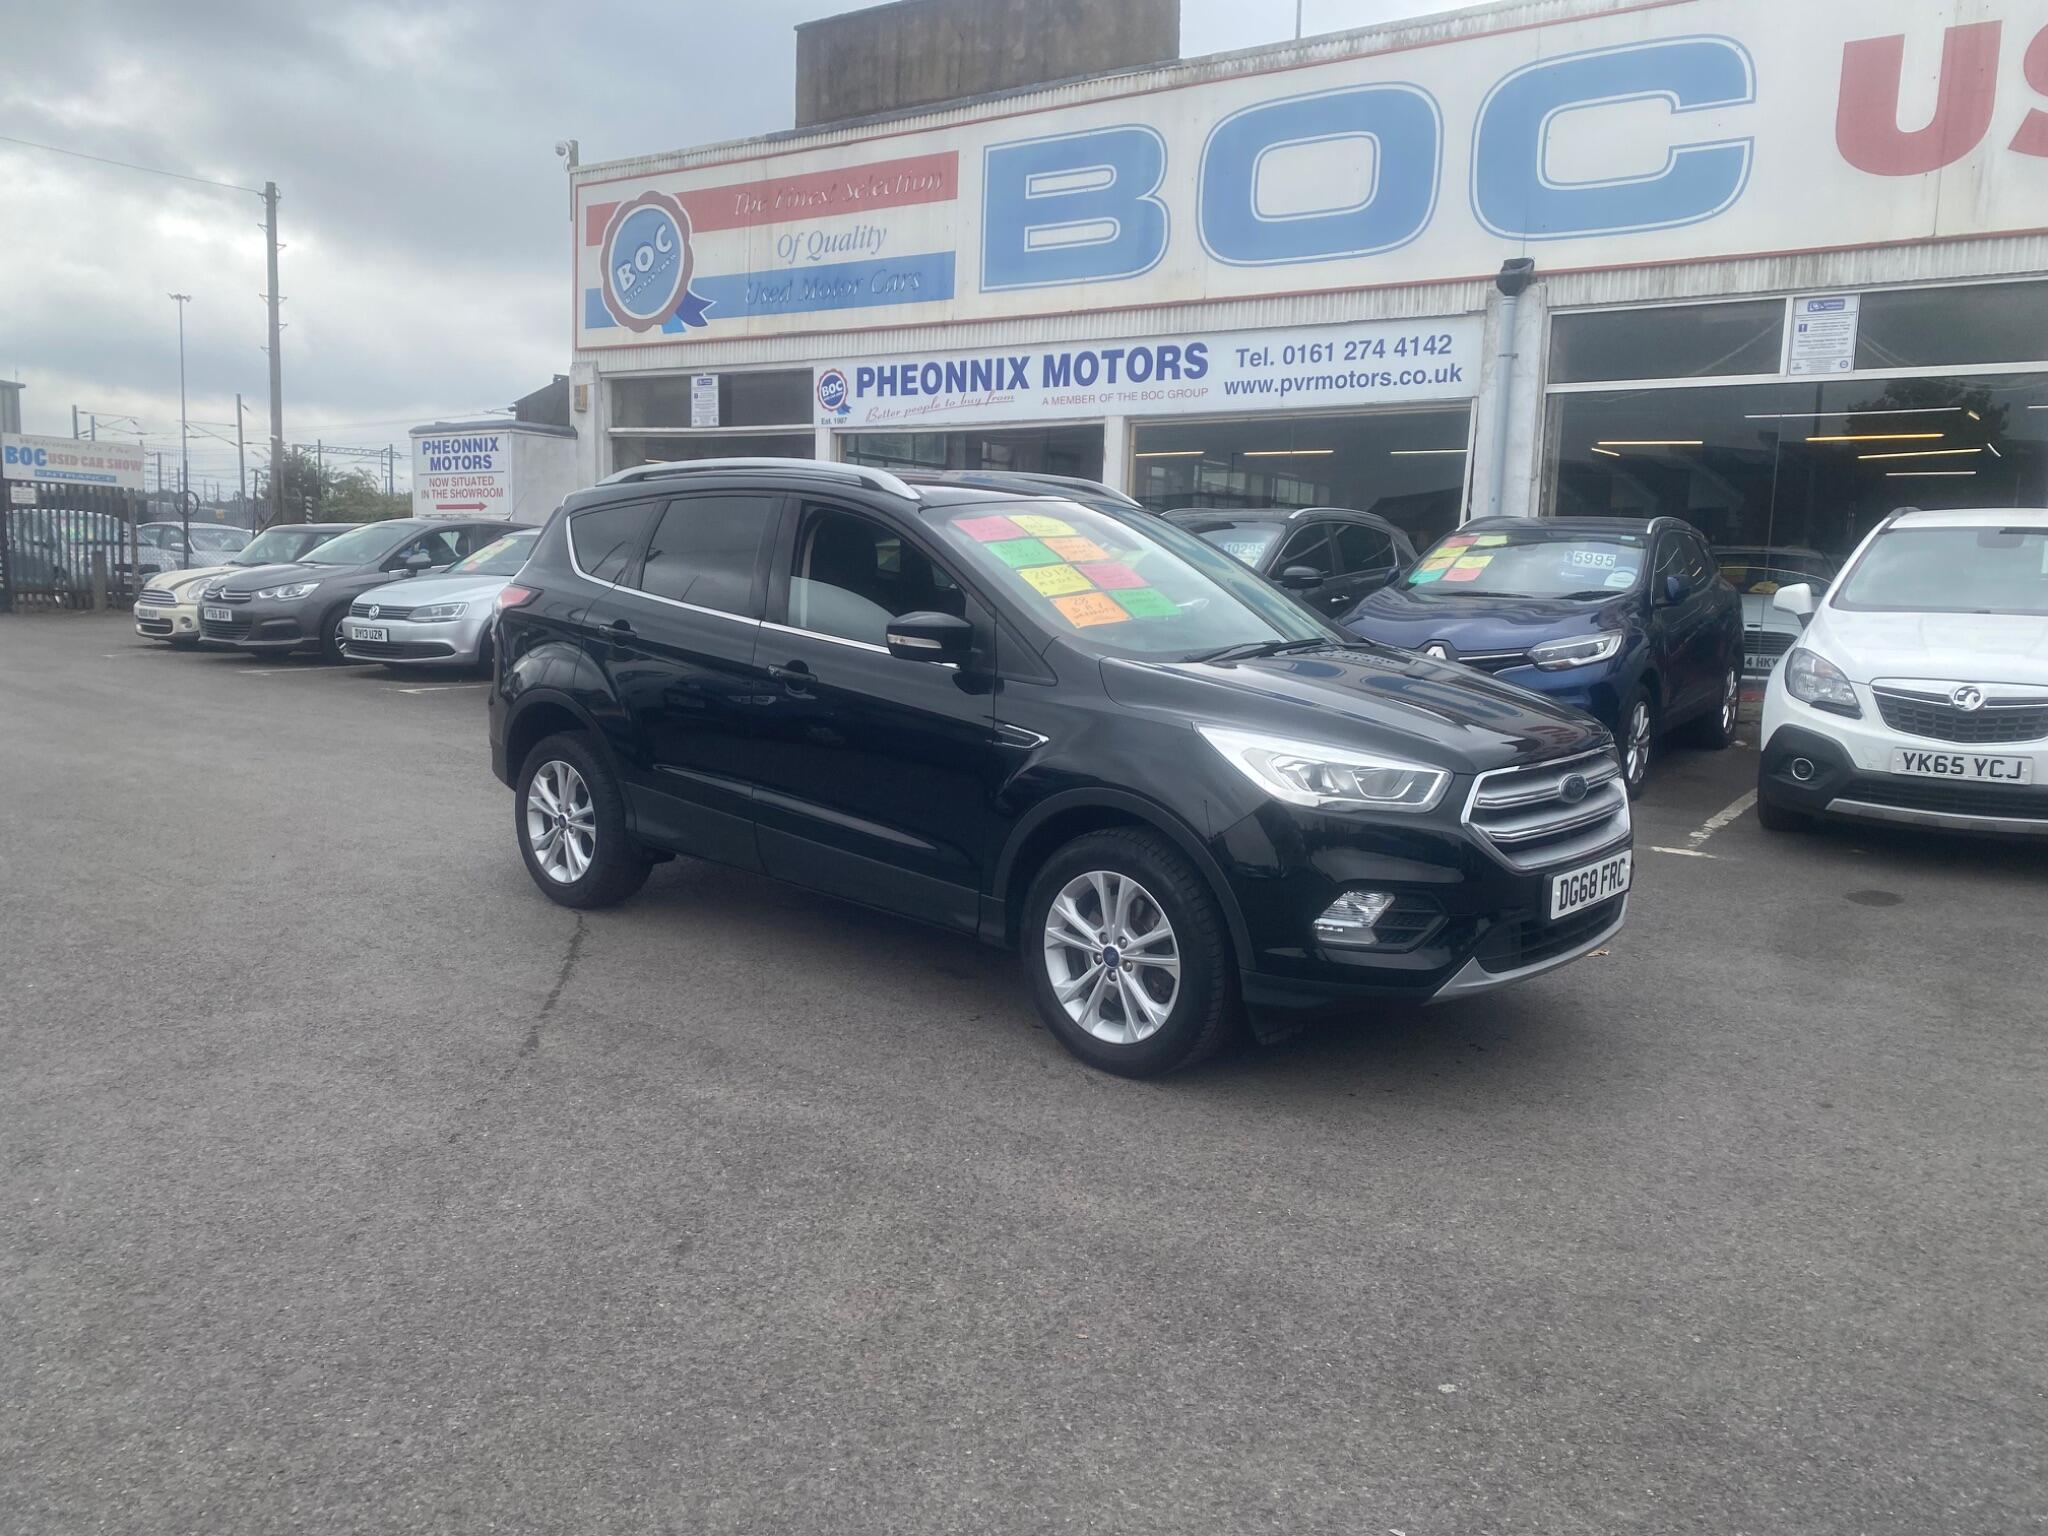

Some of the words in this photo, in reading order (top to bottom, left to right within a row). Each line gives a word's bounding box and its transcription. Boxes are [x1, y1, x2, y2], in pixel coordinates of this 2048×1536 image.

[980, 35, 1757, 293] BOC
[735, 192, 767, 216] The
[775, 183, 837, 209] Finest
[843, 170, 944, 201] Selection
[616, 222, 673, 292] BOC
[777, 232, 803, 265] Of
[807, 225, 887, 261] Quality
[745, 279, 793, 305] Used
[799, 276, 864, 302] Motor
[871, 268, 922, 296] Cars
[1236, 346, 1275, 368] Tel.
[1283, 342, 1334, 366] 0161
[1344, 338, 1386, 362] 274
[1394, 334, 1453, 358] 4142
[855, 355, 1031, 398] PHEONNIX
[1042, 342, 1209, 389] MOTORS
[1224, 363, 1463, 397] www.pvrmotors.co.uk
[821, 381, 843, 398] BOC
[1042, 397, 1050, 406] A
[1051, 395, 1096, 406] MEMBER
[1100, 393, 1114, 403] OF
[1117, 391, 1138, 402] THE
[1141, 390, 1165, 401] BOC
[1168, 388, 1209, 400] GROUP
[821, 417, 832, 425] Est.
[865, 406, 901, 423] Better
[904, 396, 941, 419] people
[945, 397, 955, 408] to
[960, 392, 982, 406] buy
[985, 389, 1015, 405] from
[4, 445, 48, 467] BOC
[48, 452, 79, 466] USED
[81, 455, 105, 469] CAR
[106, 458, 142, 472] SHOW
[422, 437, 499, 455] PHEONNIX
[430, 454, 492, 471] MOTORS
[421, 490, 430, 499] IN
[432, 489, 447, 499] THE
[450, 487, 504, 499] SHOWROOM
[429, 477, 449, 488] NOW
[451, 475, 495, 487] SITUATED
[369, 629, 383, 640] UZR
[1903, 752, 1965, 775] YK65
[1974, 758, 2022, 779] YCJ
[1558, 868, 1598, 911] DG68
[1600, 857, 1626, 895] FRC
